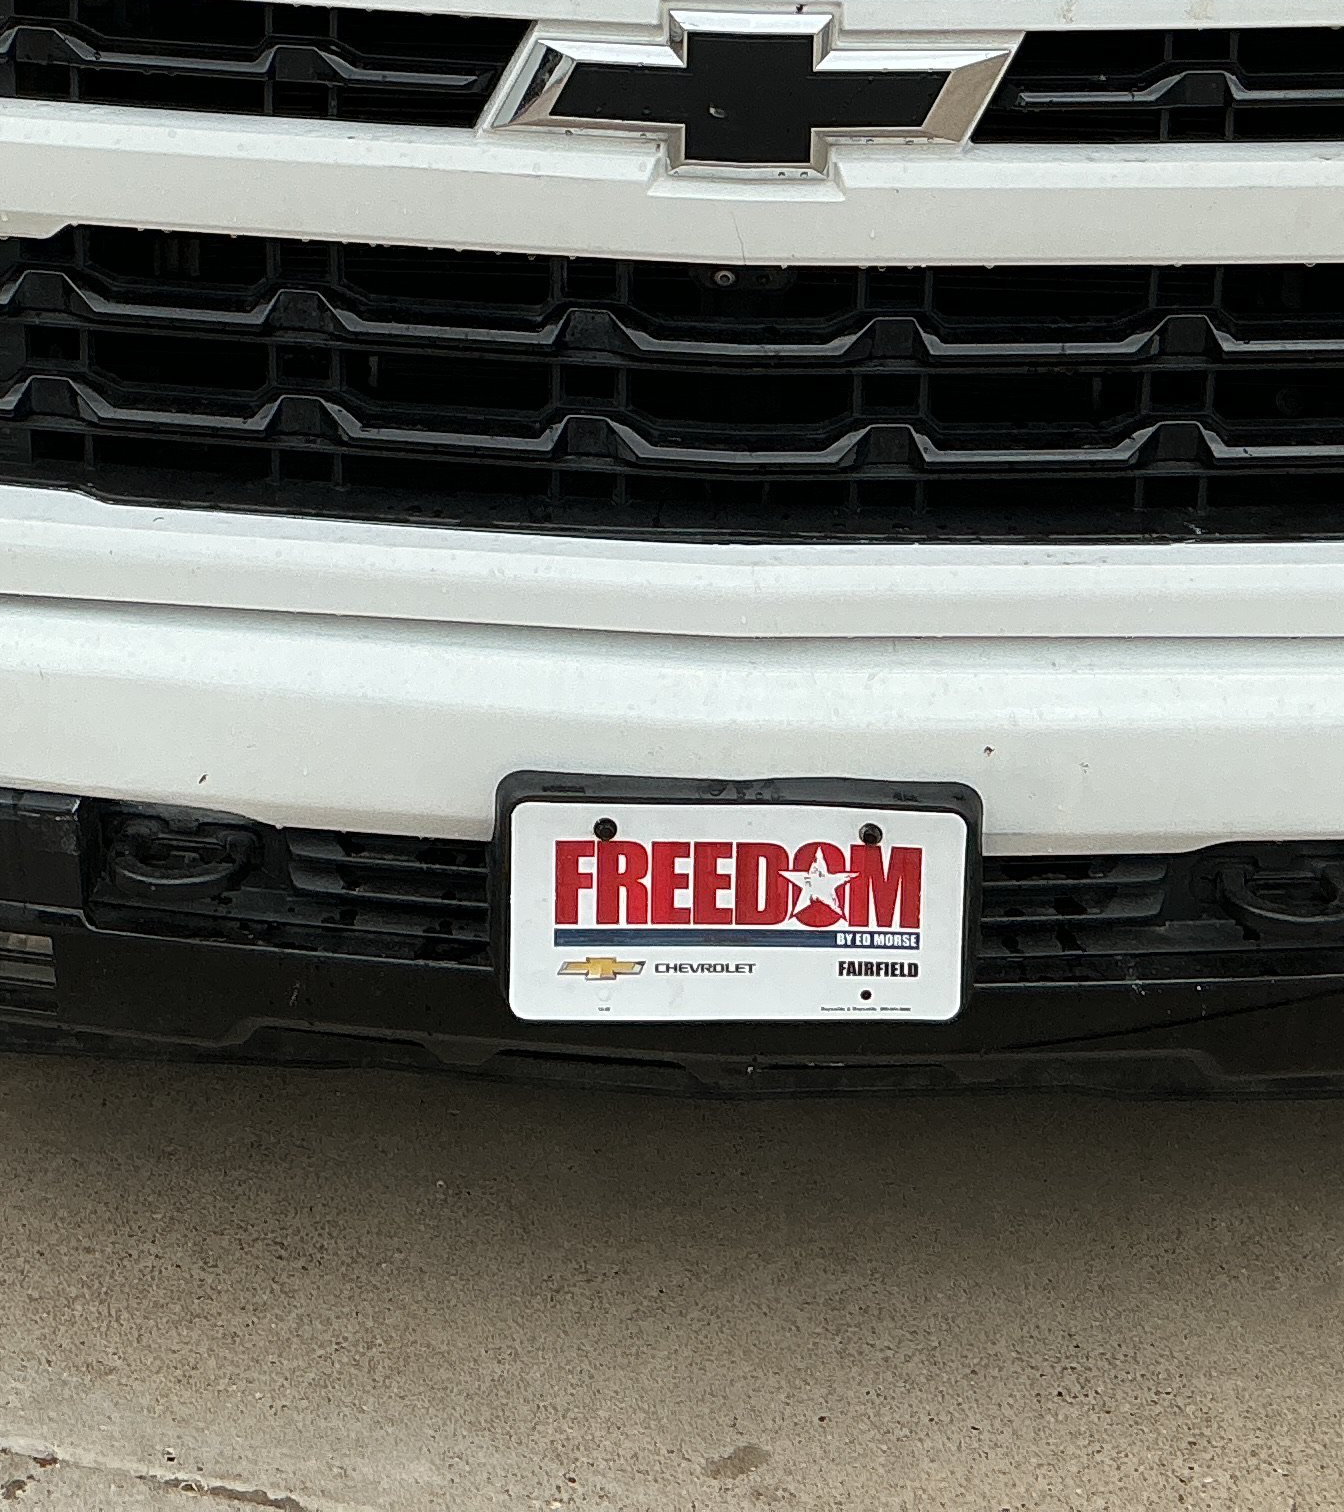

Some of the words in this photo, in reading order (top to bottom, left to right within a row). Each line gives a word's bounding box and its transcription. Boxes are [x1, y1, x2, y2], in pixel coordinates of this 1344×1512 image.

[555, 840, 923, 929] FREEDOM
[836, 932, 854, 946] BY
[855, 933, 871, 946] ED
[873, 933, 918, 947] MORSE
[654, 963, 757, 974] CHEVROLET
[838, 960, 919, 978] FAIRFIELD
